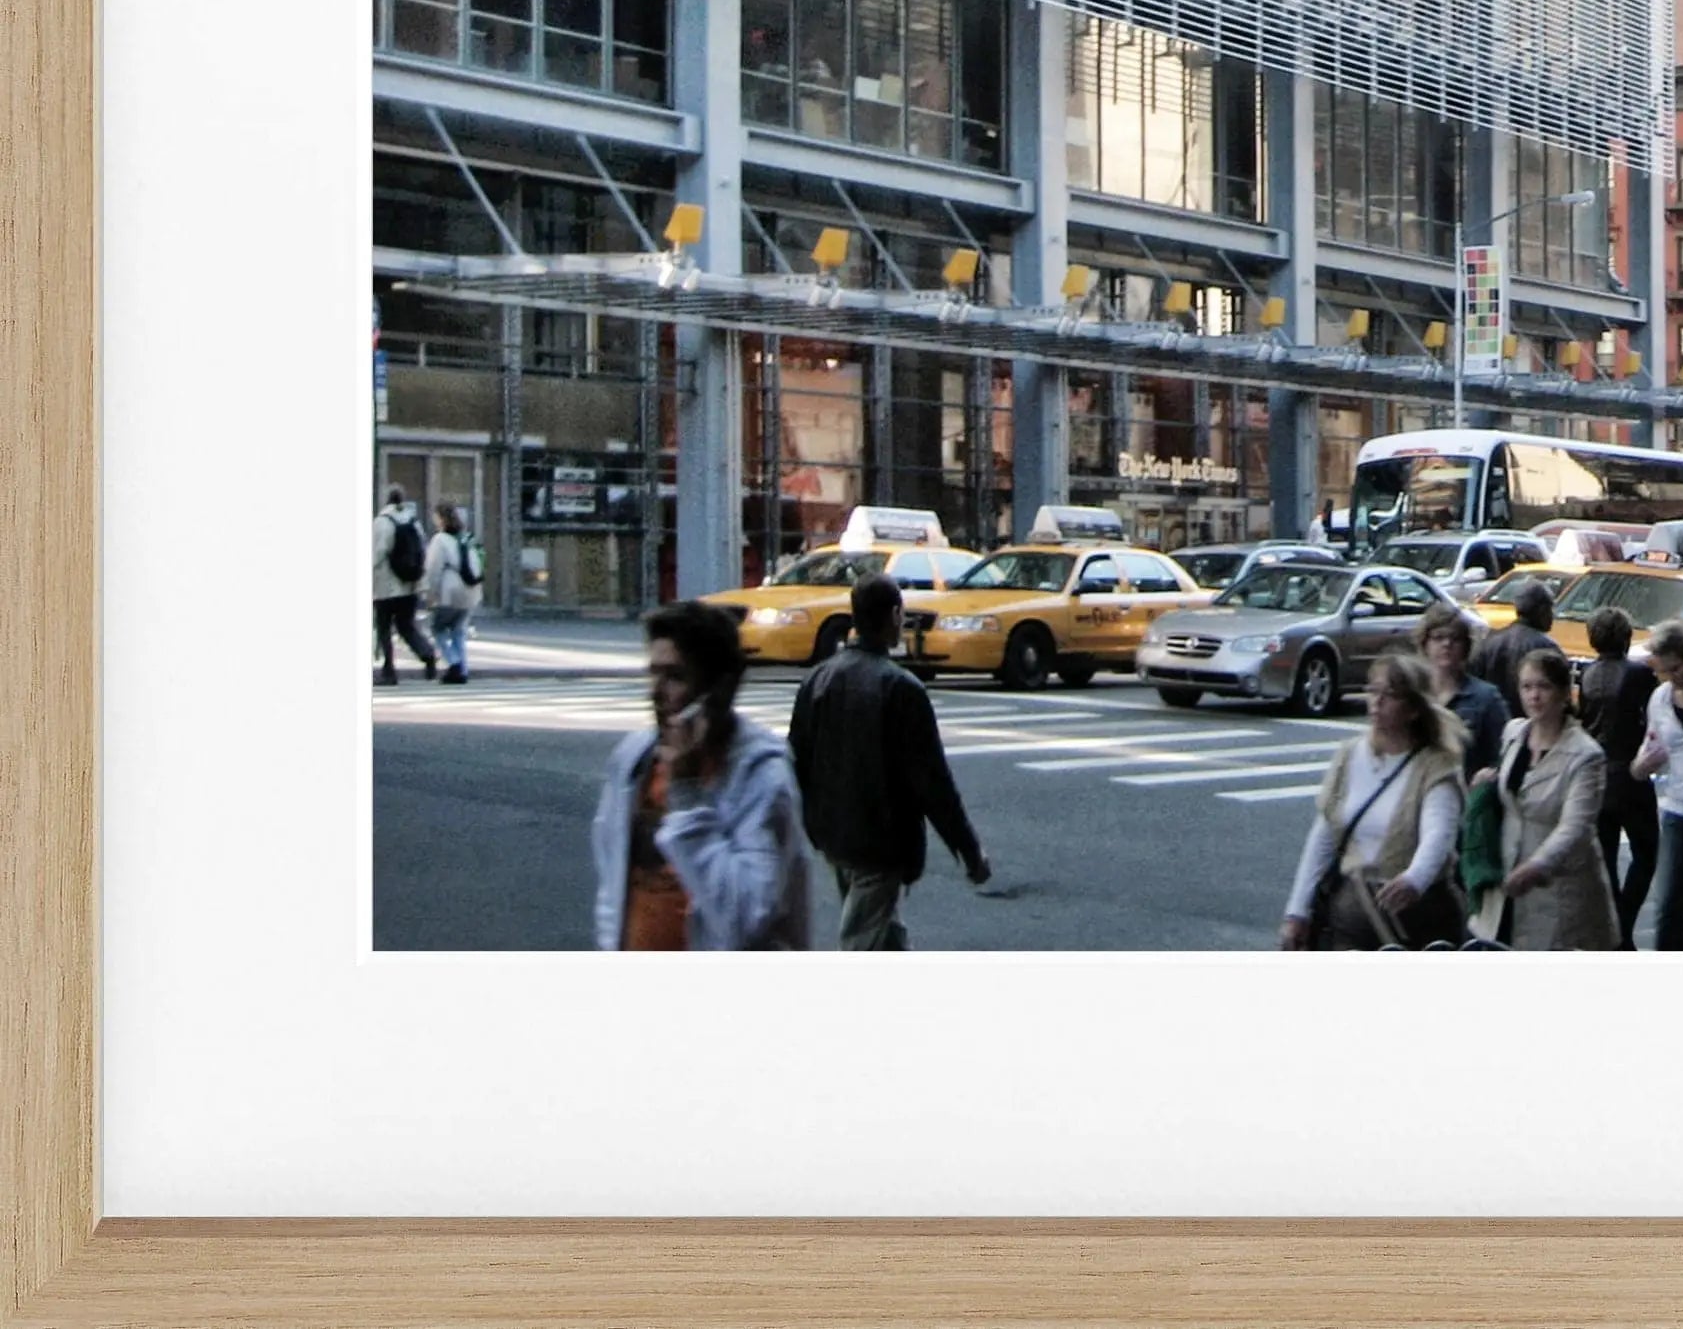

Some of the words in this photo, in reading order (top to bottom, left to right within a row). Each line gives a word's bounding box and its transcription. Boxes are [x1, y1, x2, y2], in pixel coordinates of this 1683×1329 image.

[1118, 452, 1143, 479] The
[1143, 452, 1170, 479] New
[1201, 457, 1239, 482] Times
